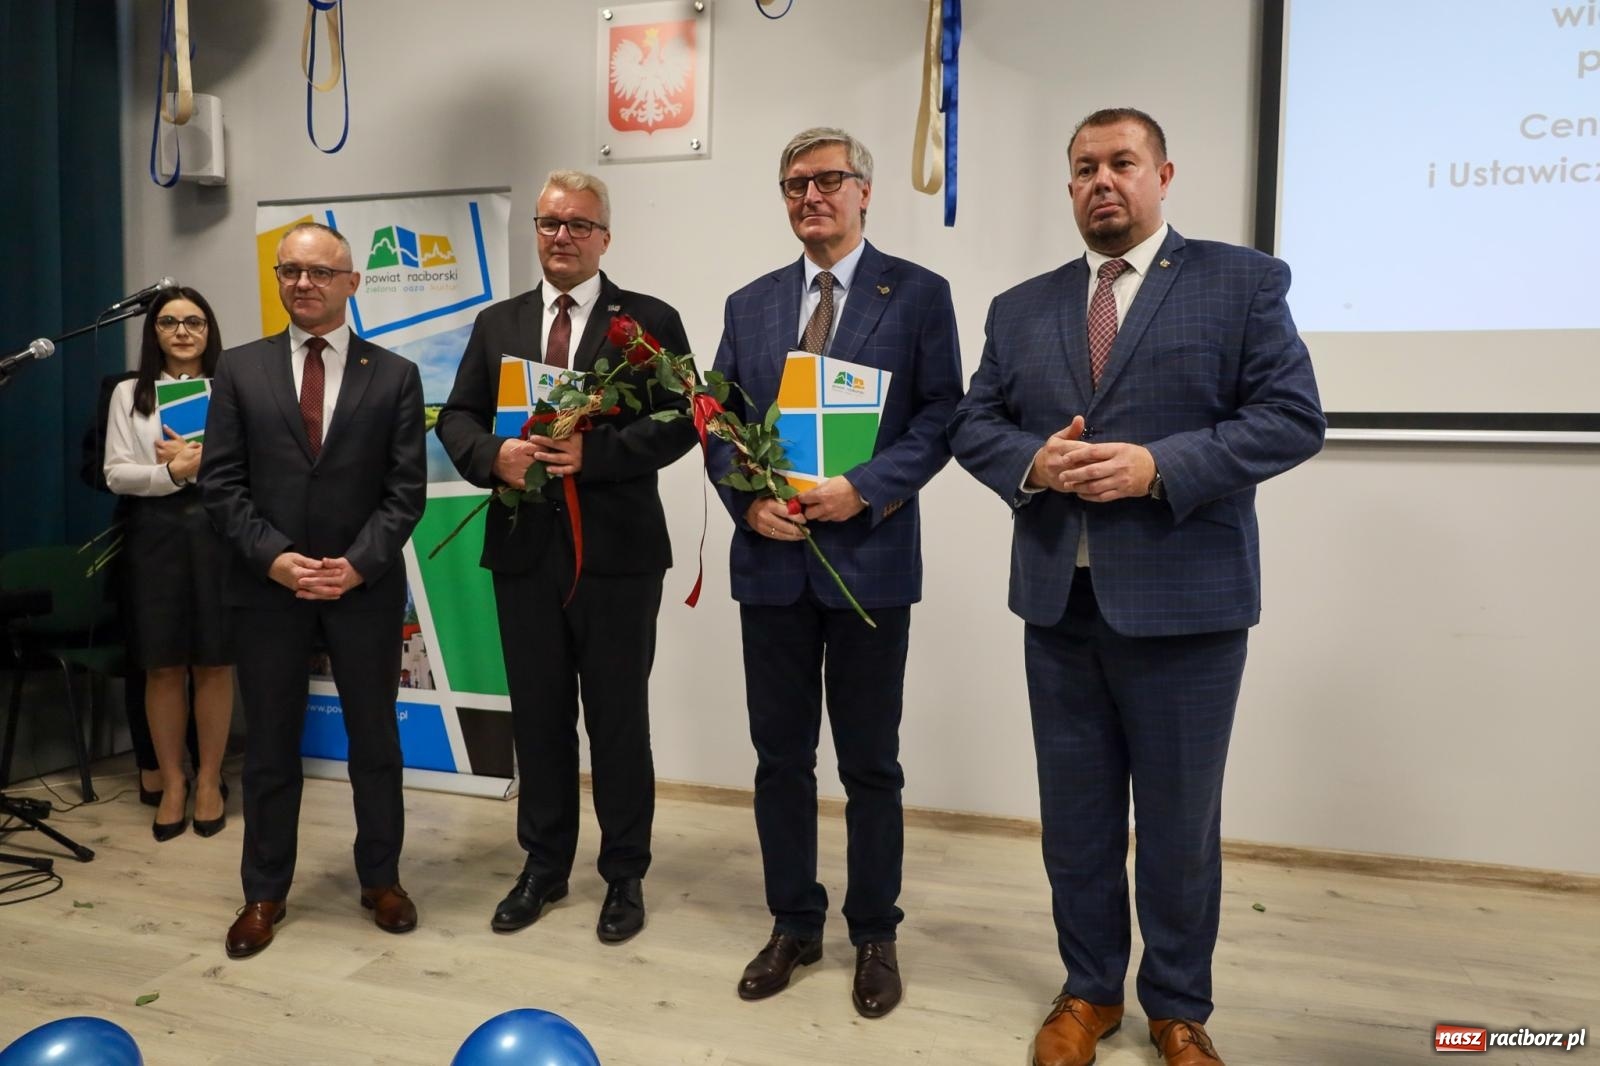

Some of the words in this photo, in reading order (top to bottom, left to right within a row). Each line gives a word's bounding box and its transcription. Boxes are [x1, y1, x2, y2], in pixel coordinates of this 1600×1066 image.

[1552, 0, 1600, 28] wi
[1519, 113, 1598, 140] Cen
[1428, 162, 1436, 188] i
[365, 271, 400, 285] powiat
[408, 268, 458, 282] raciborski
